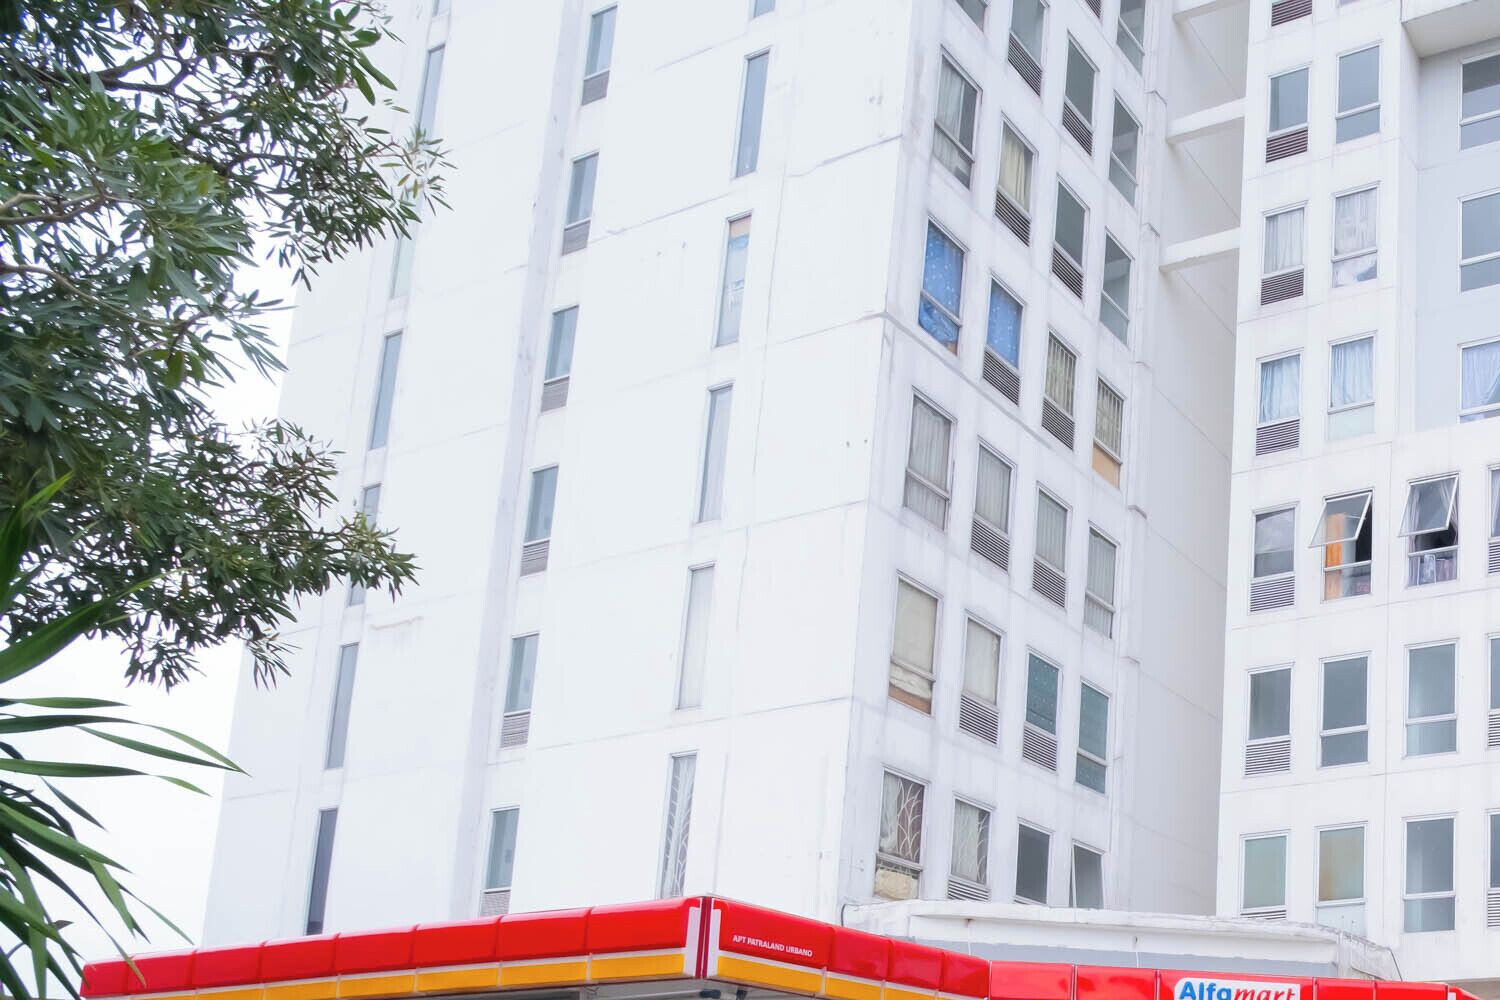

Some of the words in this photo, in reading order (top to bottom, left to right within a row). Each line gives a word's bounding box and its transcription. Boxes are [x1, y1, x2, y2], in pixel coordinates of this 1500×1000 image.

[733, 934, 746, 944] APT
[747, 937, 785, 952] PATRALAND
[786, 945, 813, 957] URBANO
